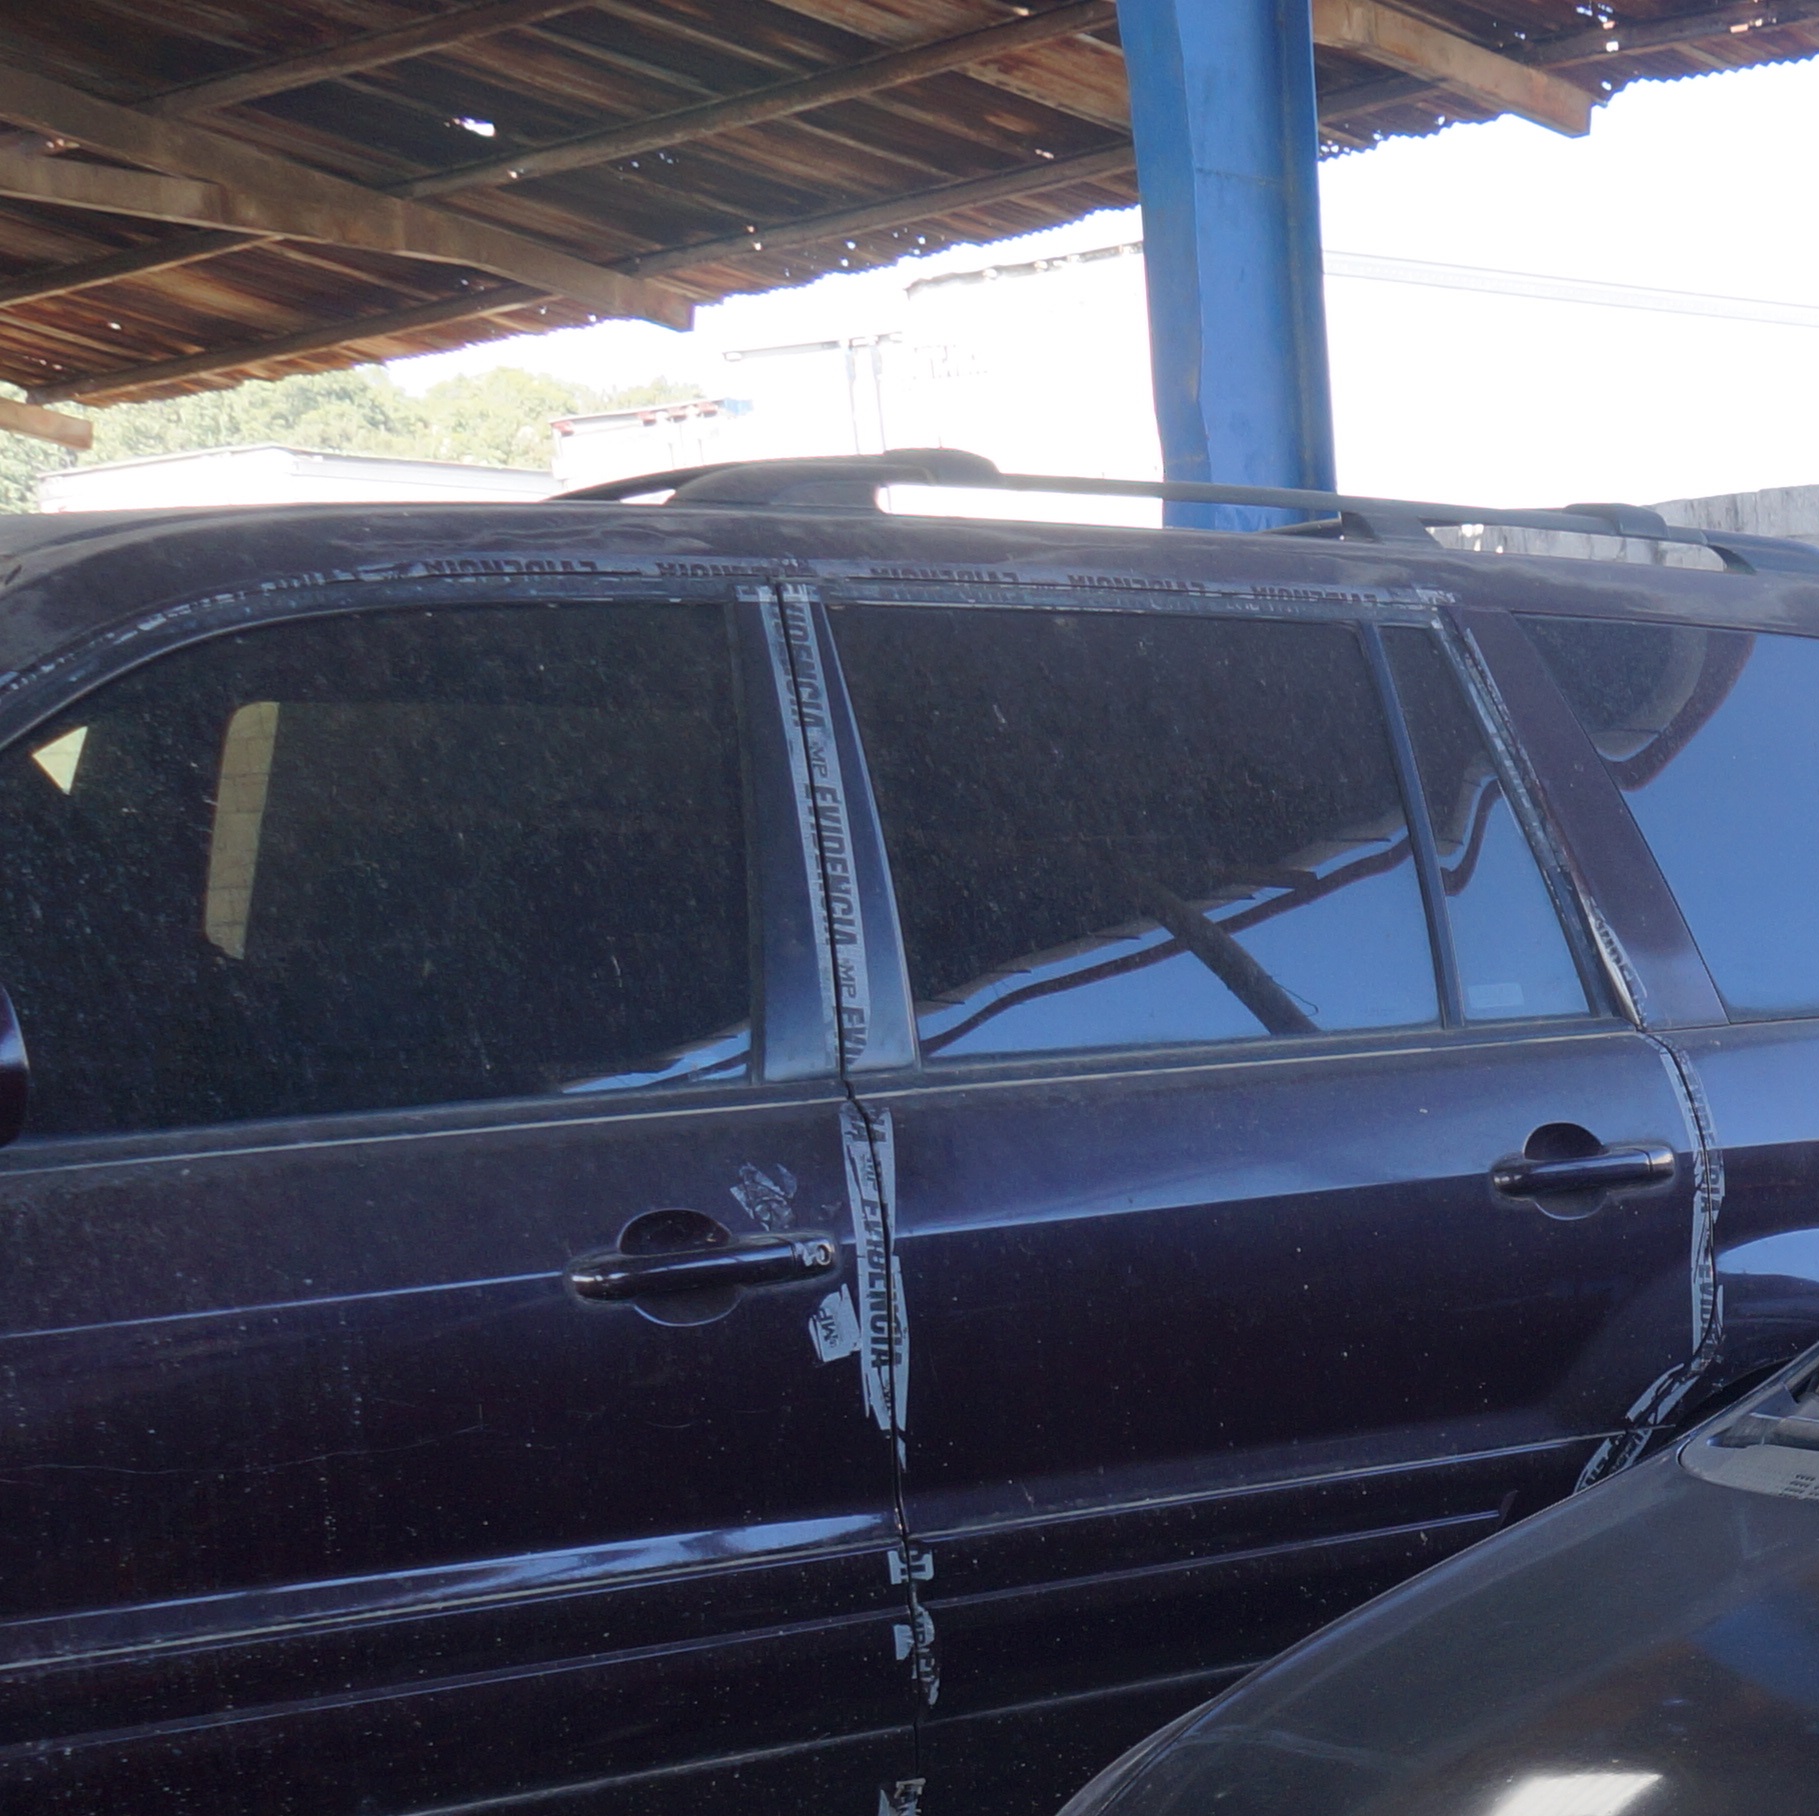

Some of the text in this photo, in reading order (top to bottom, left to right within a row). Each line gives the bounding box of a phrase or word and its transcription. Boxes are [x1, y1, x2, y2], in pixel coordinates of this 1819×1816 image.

[804, 783, 857, 946] EVIDENCIA
[839, 965, 857, 999] MP
[861, 1199, 904, 1369] EVIDENCIA
